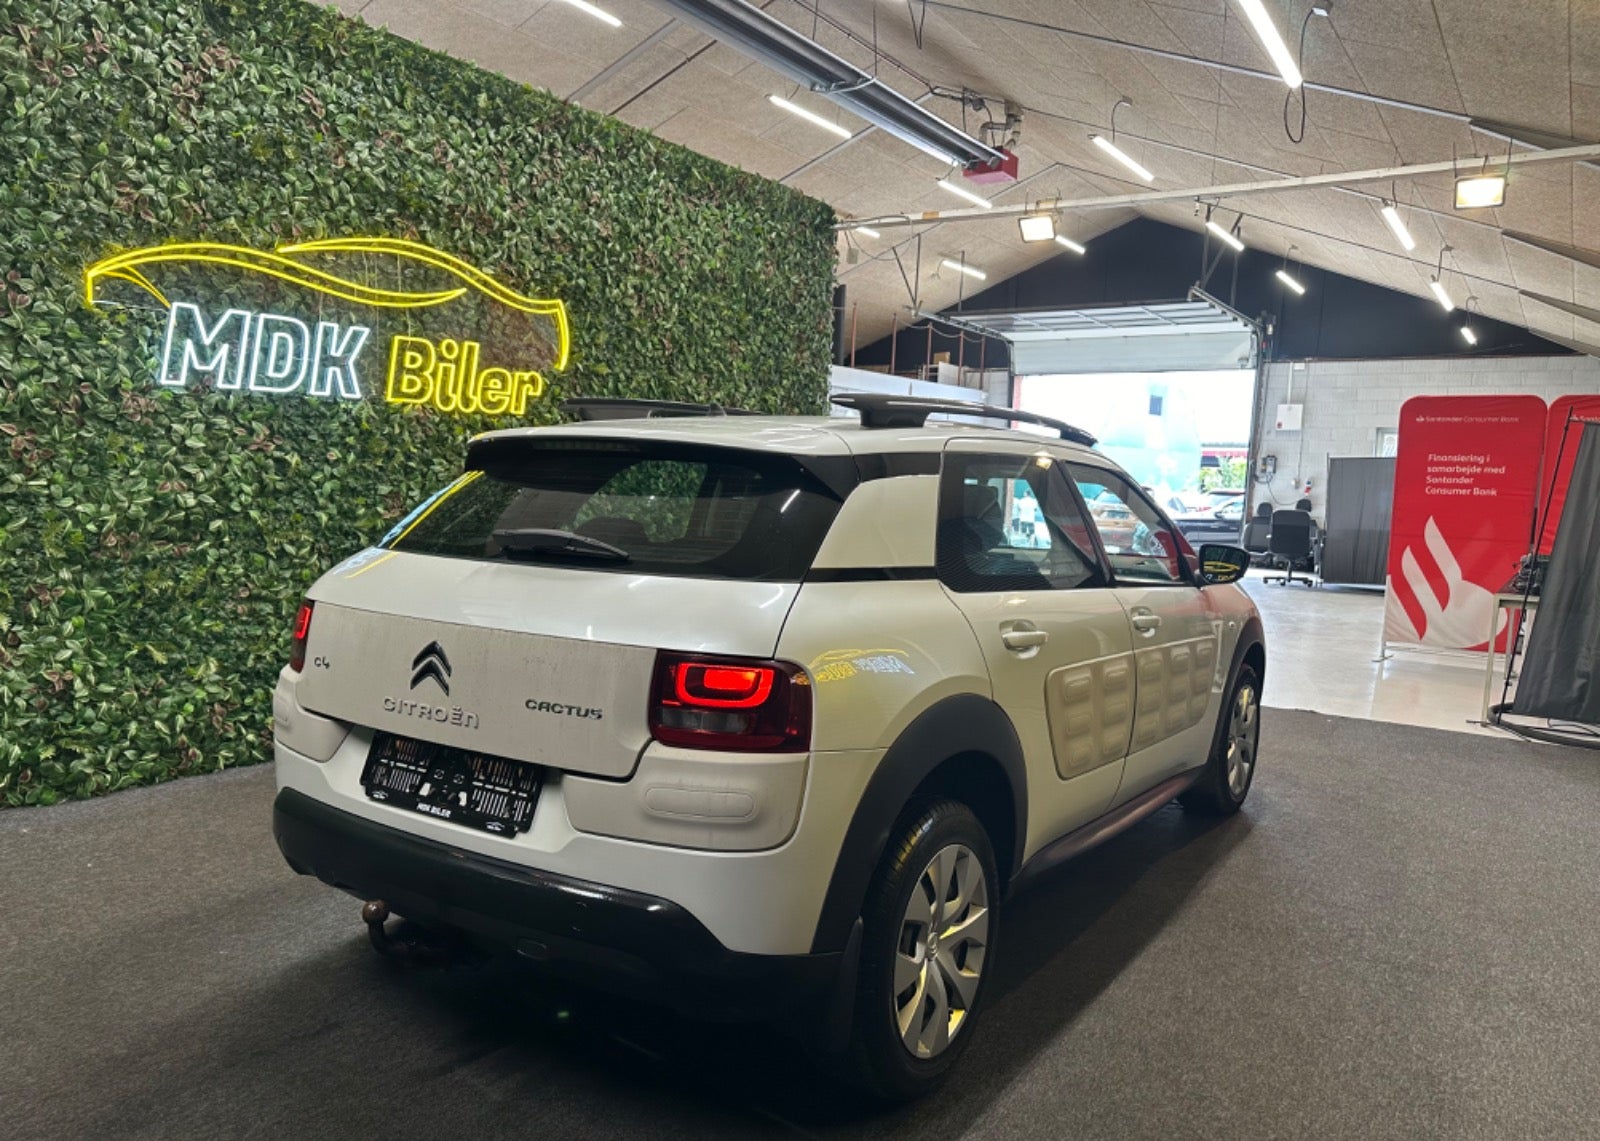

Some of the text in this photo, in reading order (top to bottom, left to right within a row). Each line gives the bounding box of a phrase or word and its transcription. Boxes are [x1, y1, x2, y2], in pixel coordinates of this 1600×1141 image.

[160, 302, 542, 415] MDK Biler
[1428, 454, 1484, 463] Finansiering
[1427, 465, 1505, 474] samarbejde med
[1425, 475, 1474, 484] Santander
[1425, 486, 1497, 497] Consumer Bank
[525, 698, 603, 721] CACTUS
